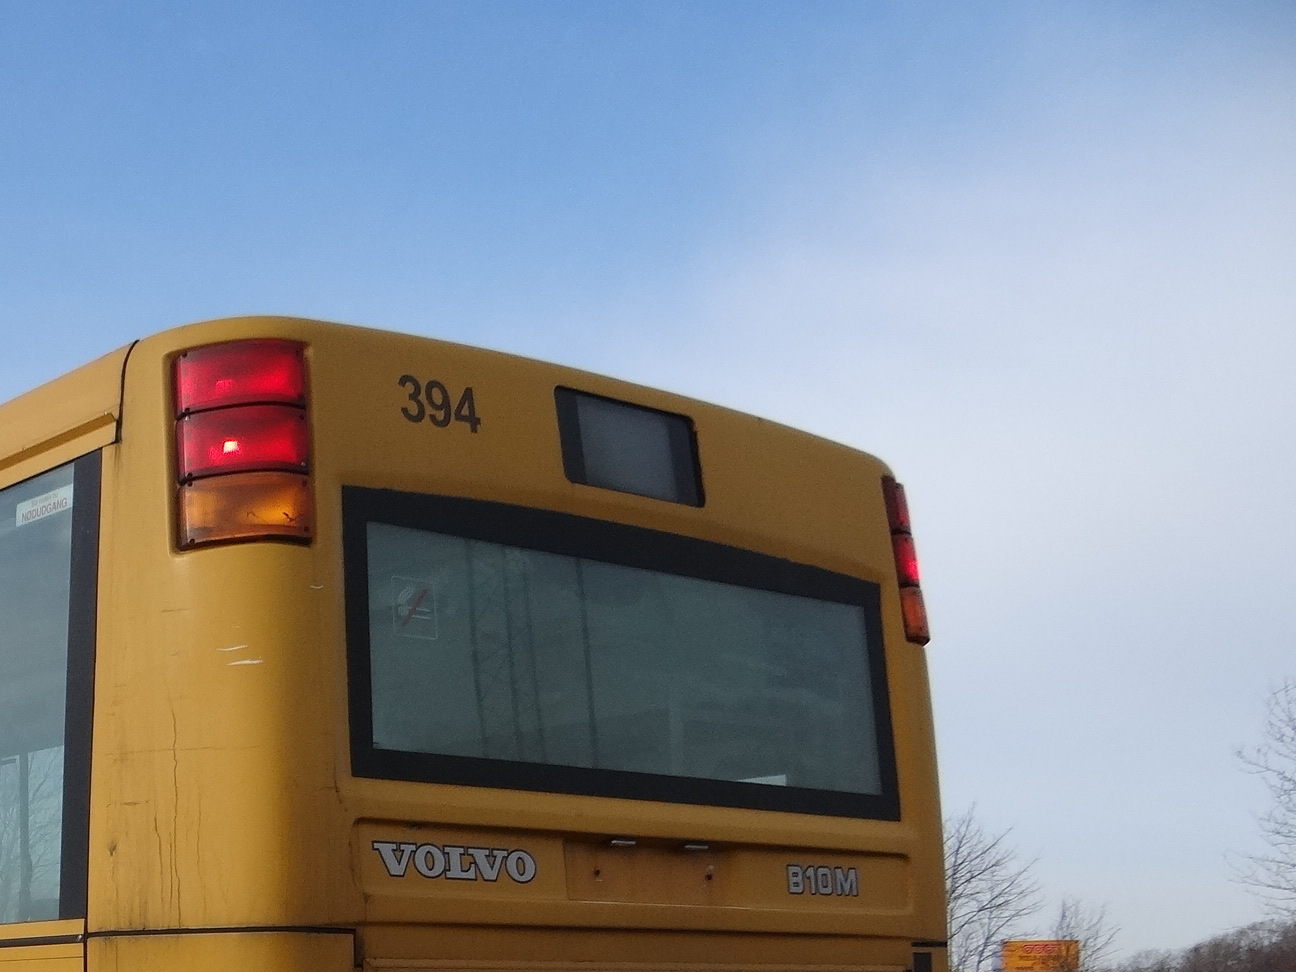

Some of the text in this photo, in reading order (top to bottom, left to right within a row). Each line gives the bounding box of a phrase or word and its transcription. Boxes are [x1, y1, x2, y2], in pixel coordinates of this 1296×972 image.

[398, 374, 481, 434] 394
[372, 840, 537, 884] VOLVO
[786, 864, 859, 896] B10M
